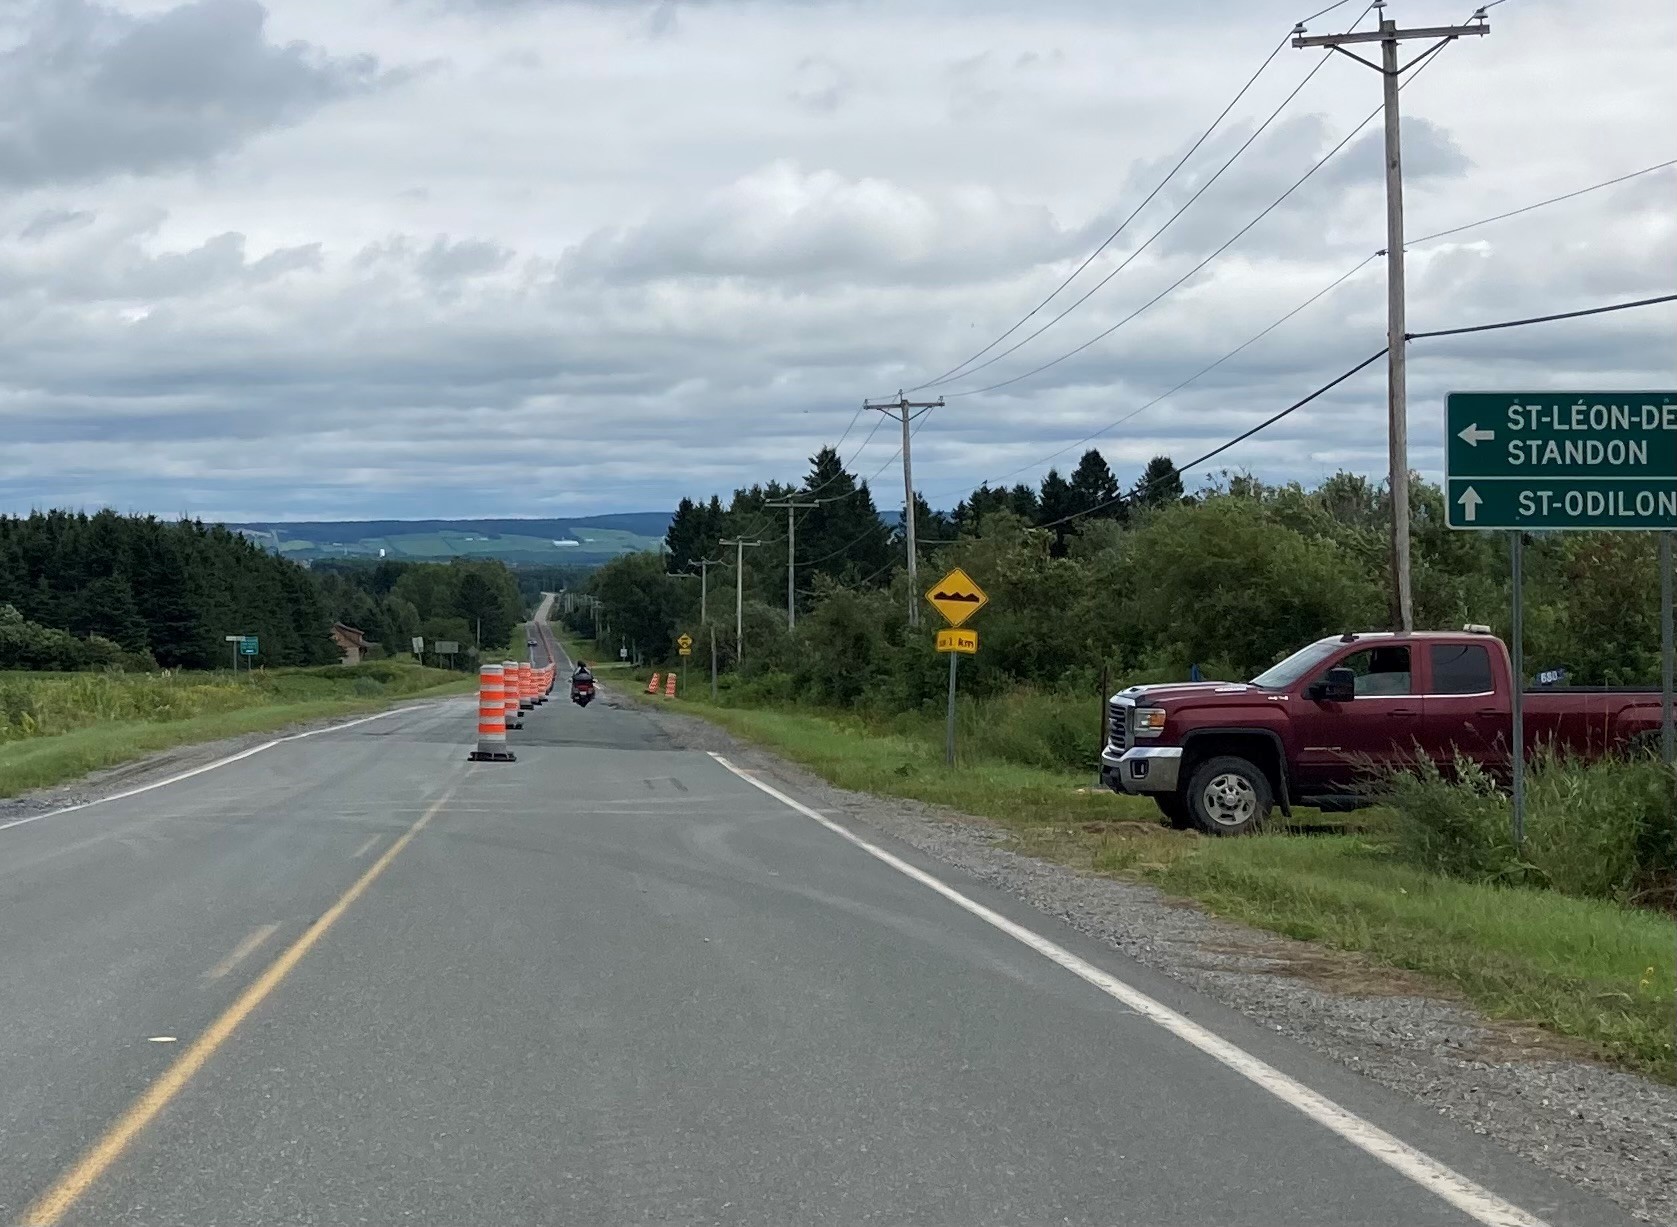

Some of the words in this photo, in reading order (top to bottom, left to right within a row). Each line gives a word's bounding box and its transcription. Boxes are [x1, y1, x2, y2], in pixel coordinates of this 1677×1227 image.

[1507, 399, 1677, 430] ST-LÉON-DE
[1507, 439, 1647, 465] STANDON
[1518, 490, 1677, 516] ST-ODILON
[958, 637, 974, 649] km
